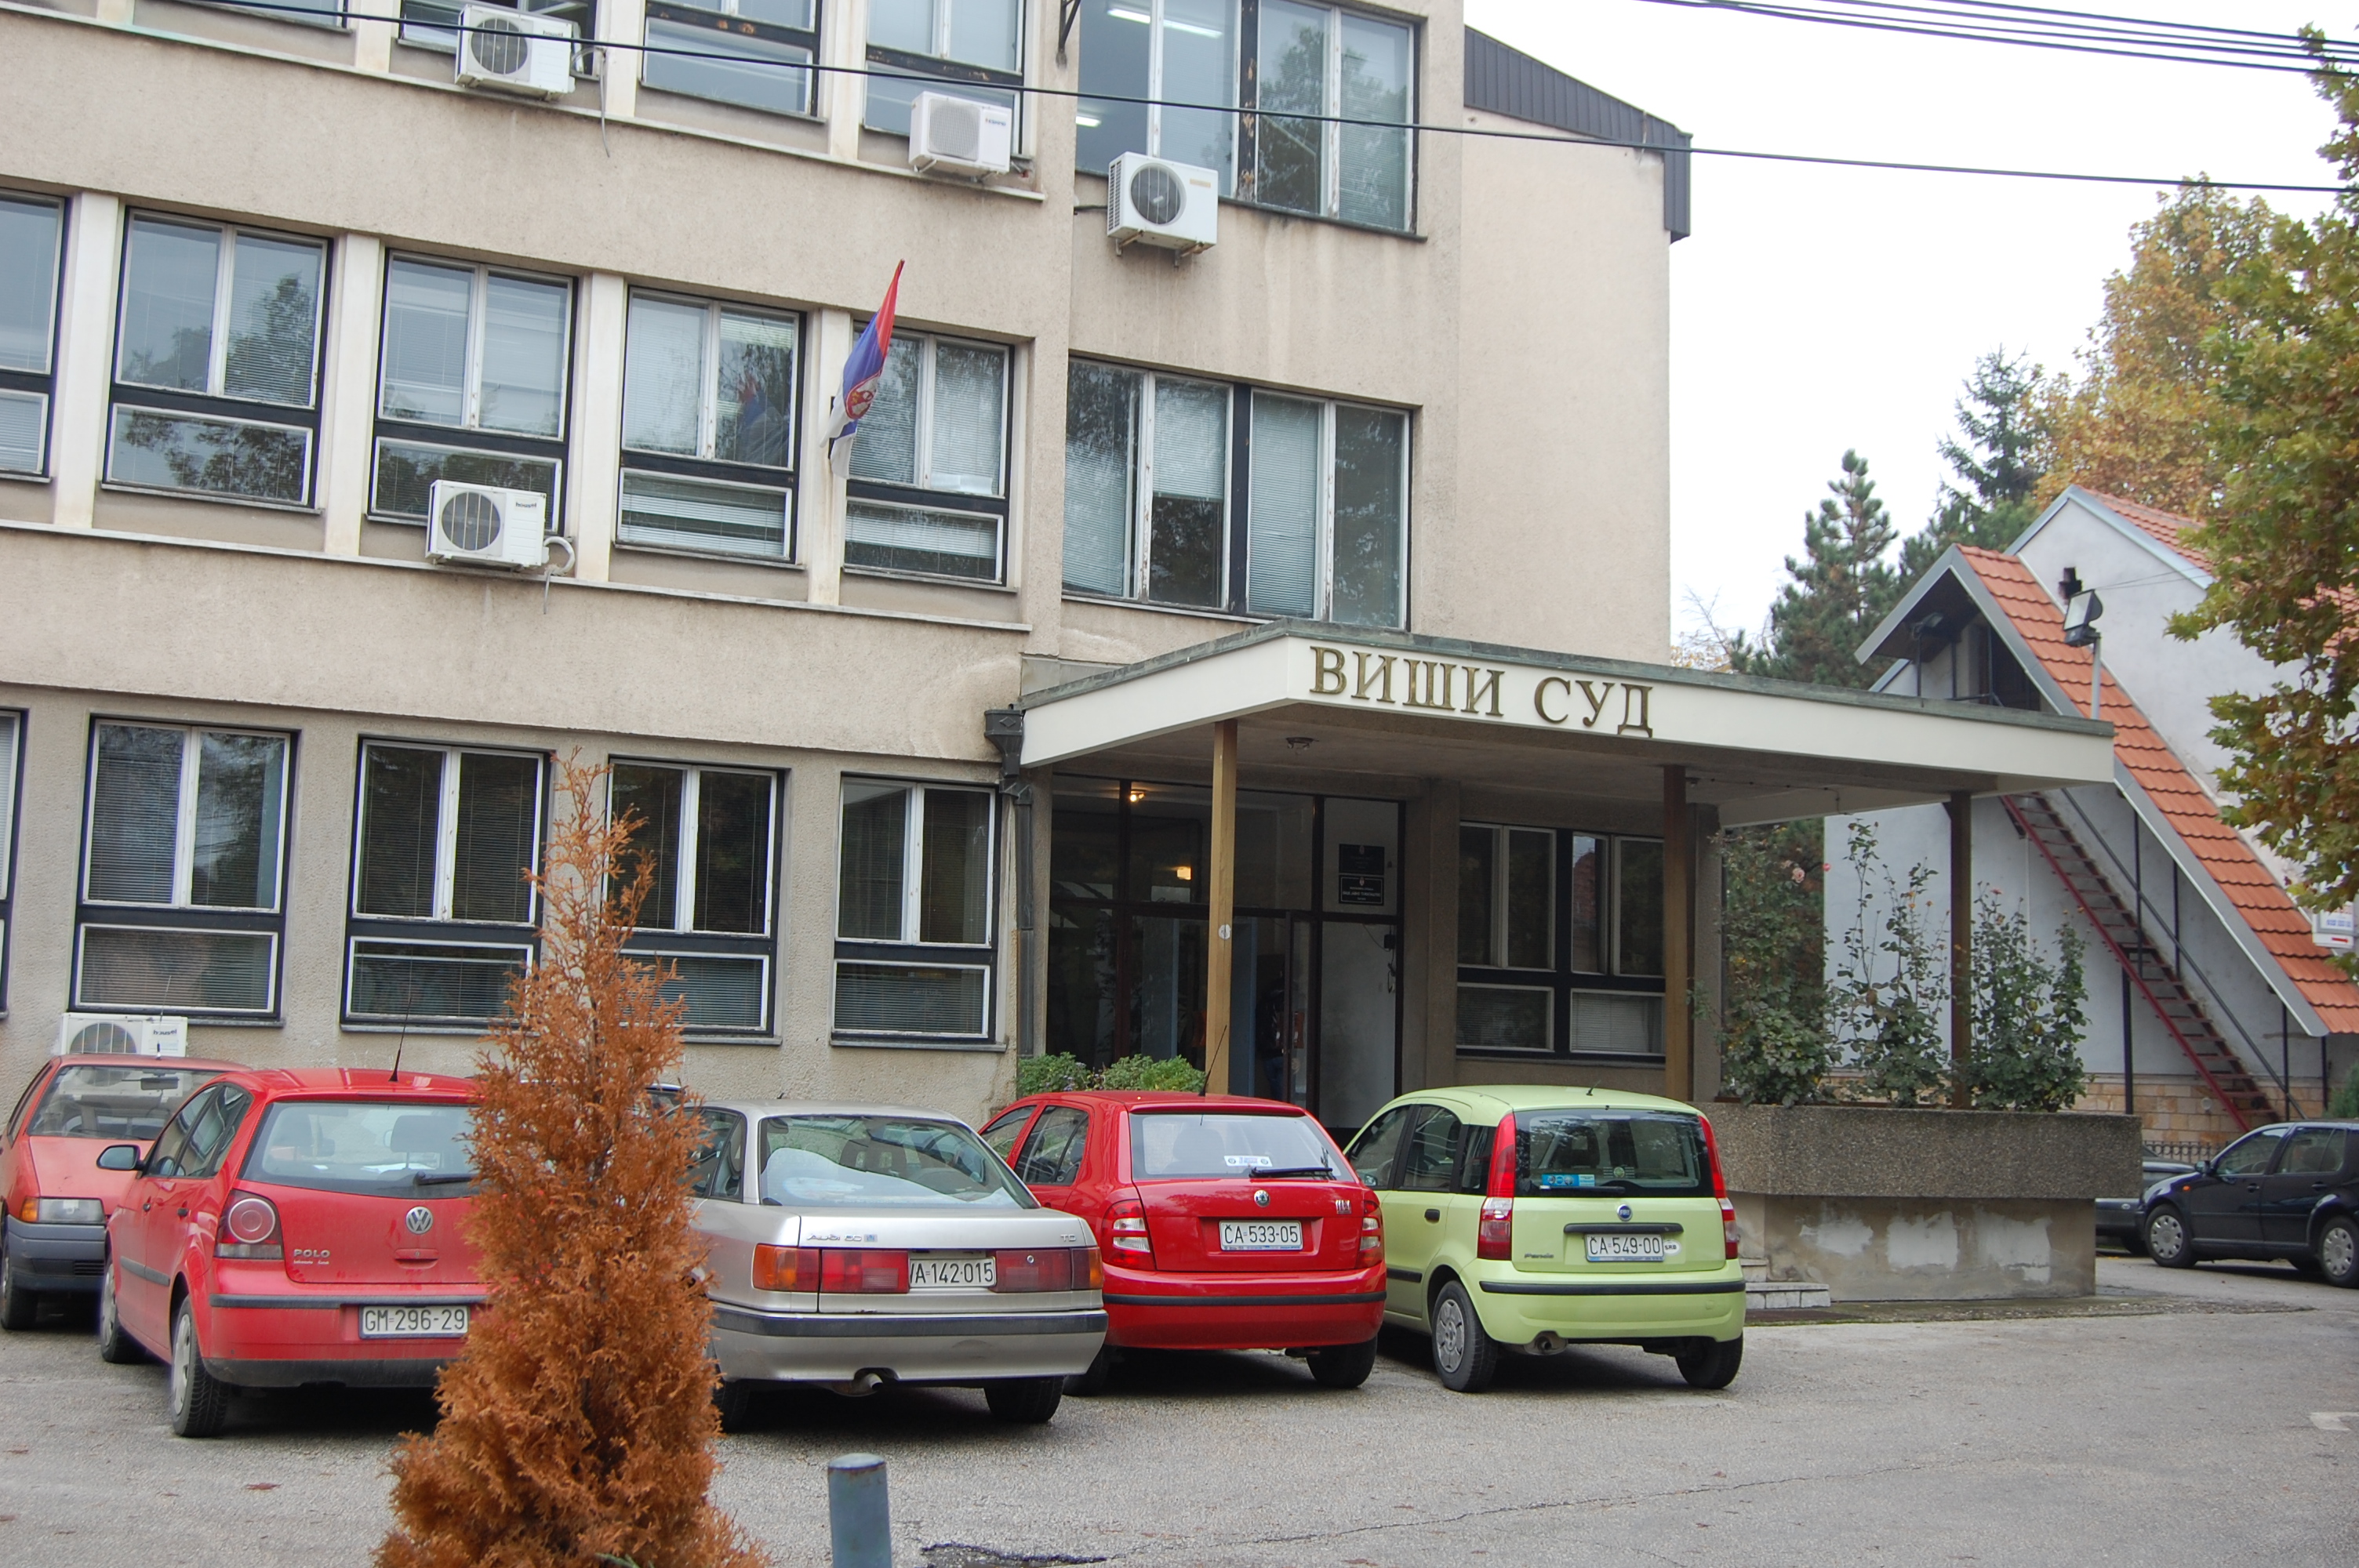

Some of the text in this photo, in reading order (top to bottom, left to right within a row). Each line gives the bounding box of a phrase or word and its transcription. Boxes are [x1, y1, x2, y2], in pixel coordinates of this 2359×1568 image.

[1309, 645, 1653, 739] ВИШИ СУД
[293, 1249, 331, 1258] POLO
